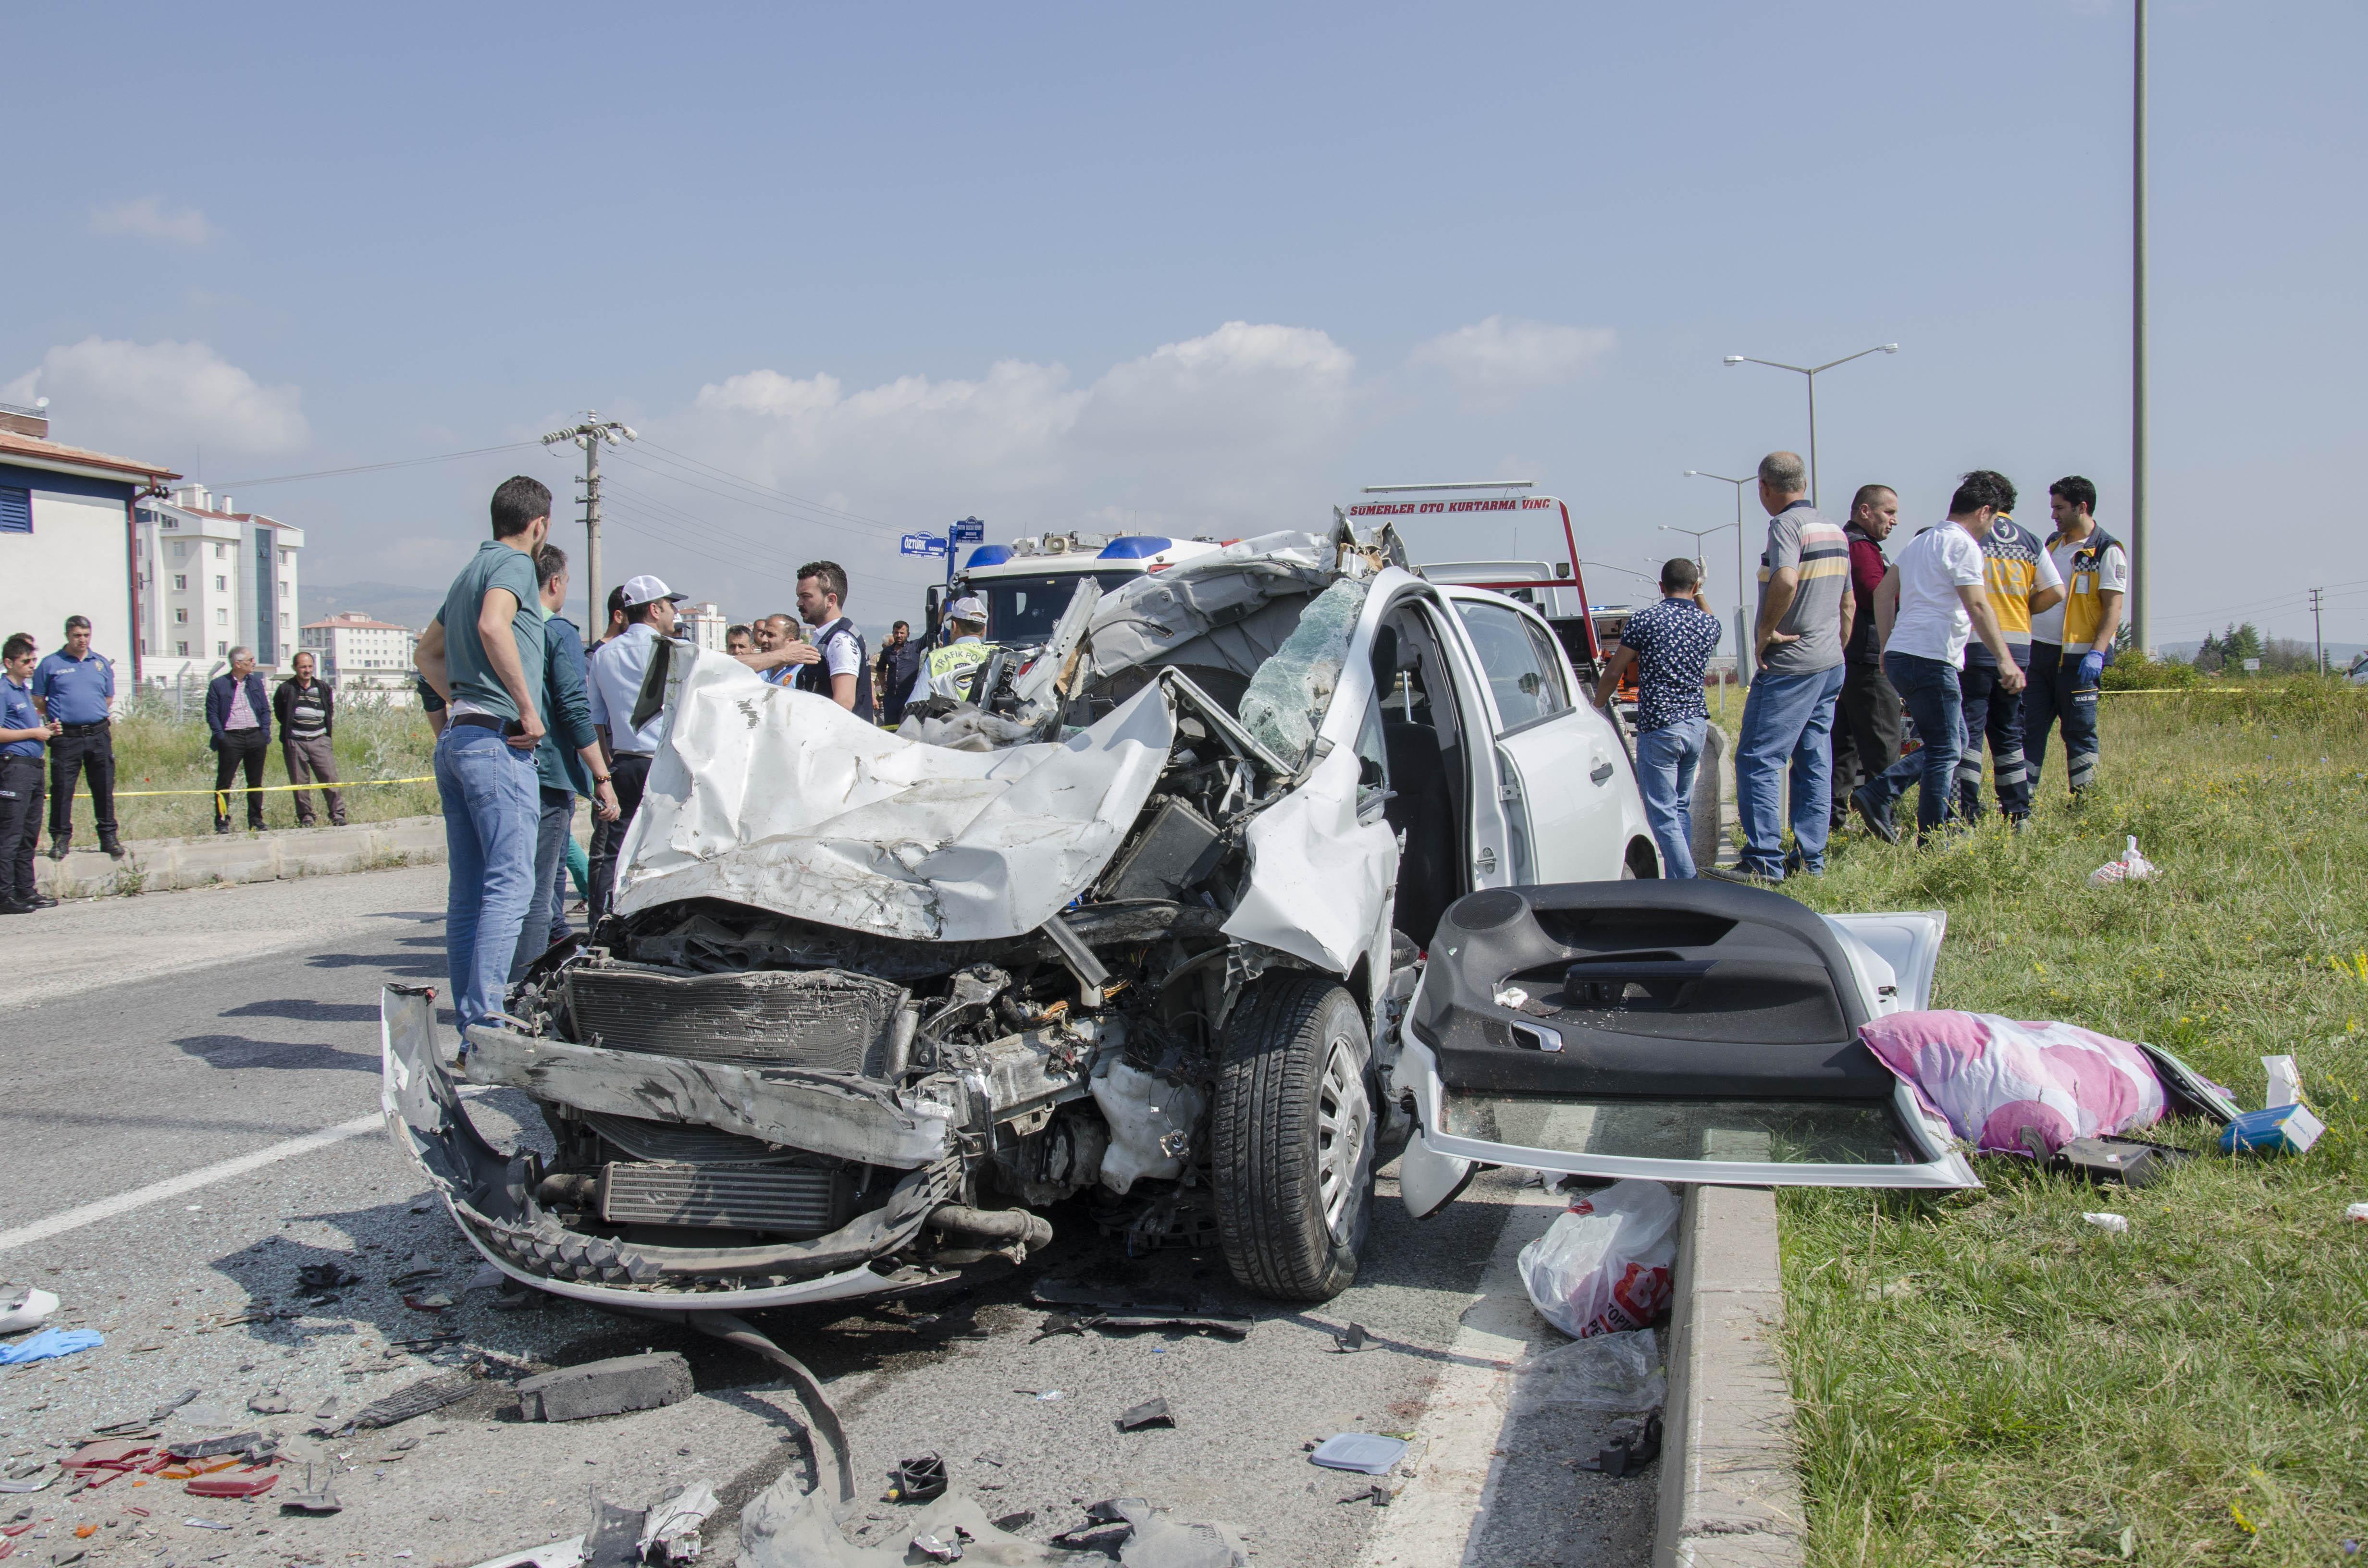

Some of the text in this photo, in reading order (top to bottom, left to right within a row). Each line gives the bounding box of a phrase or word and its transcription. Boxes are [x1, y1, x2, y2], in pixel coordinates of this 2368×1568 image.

[1350, 503, 1415, 515] SÜMERLER
[1419, 502, 1444, 513] OTO
[1448, 500, 1516, 512] KURTARMA
[904, 537, 926, 550] ÖZTÜRK
[1986, 560, 2023, 582] 112
